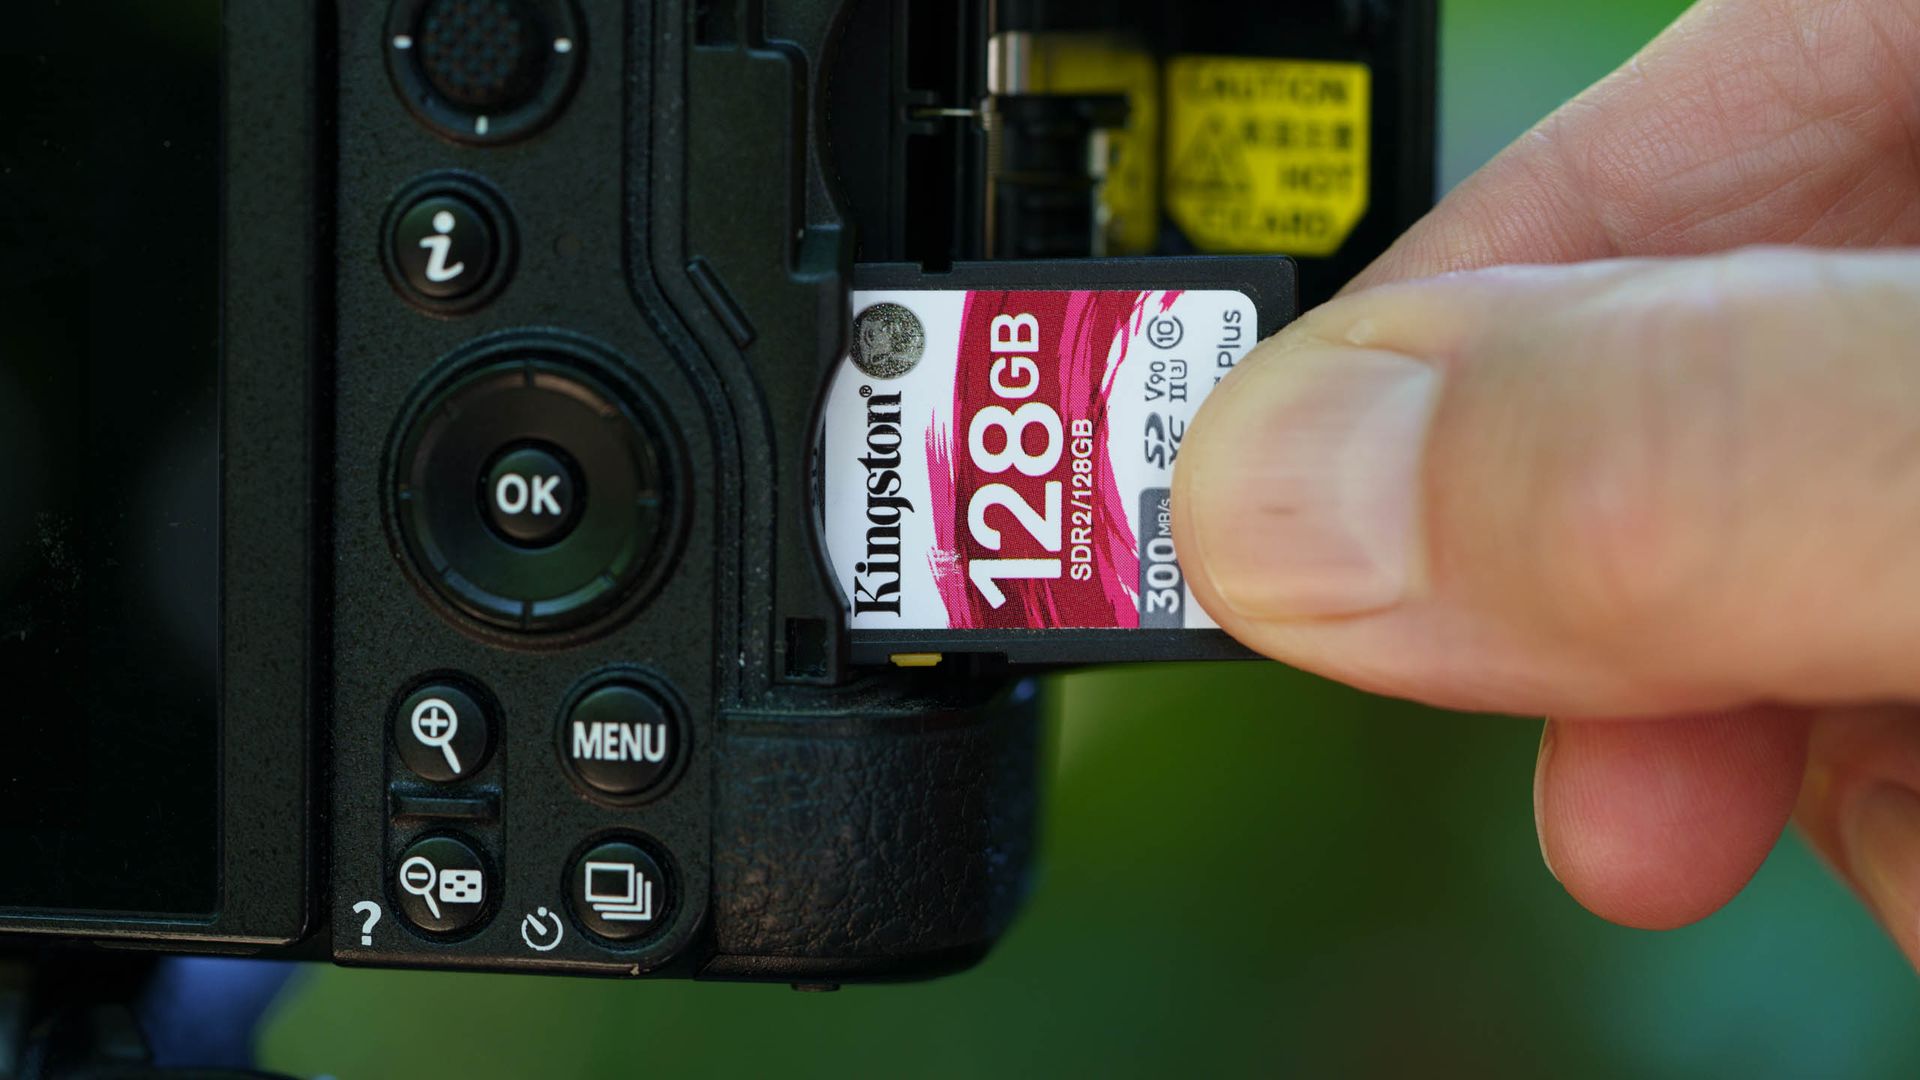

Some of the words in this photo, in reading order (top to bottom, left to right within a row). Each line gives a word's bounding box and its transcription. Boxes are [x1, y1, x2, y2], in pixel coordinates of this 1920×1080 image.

[1216, 309, 1242, 369] Plus
[1144, 360, 1167, 402] V90
[496, 473, 562, 515] OK
[1071, 418, 1093, 581] SDR2/128GB
[572, 721, 666, 763] MENU
